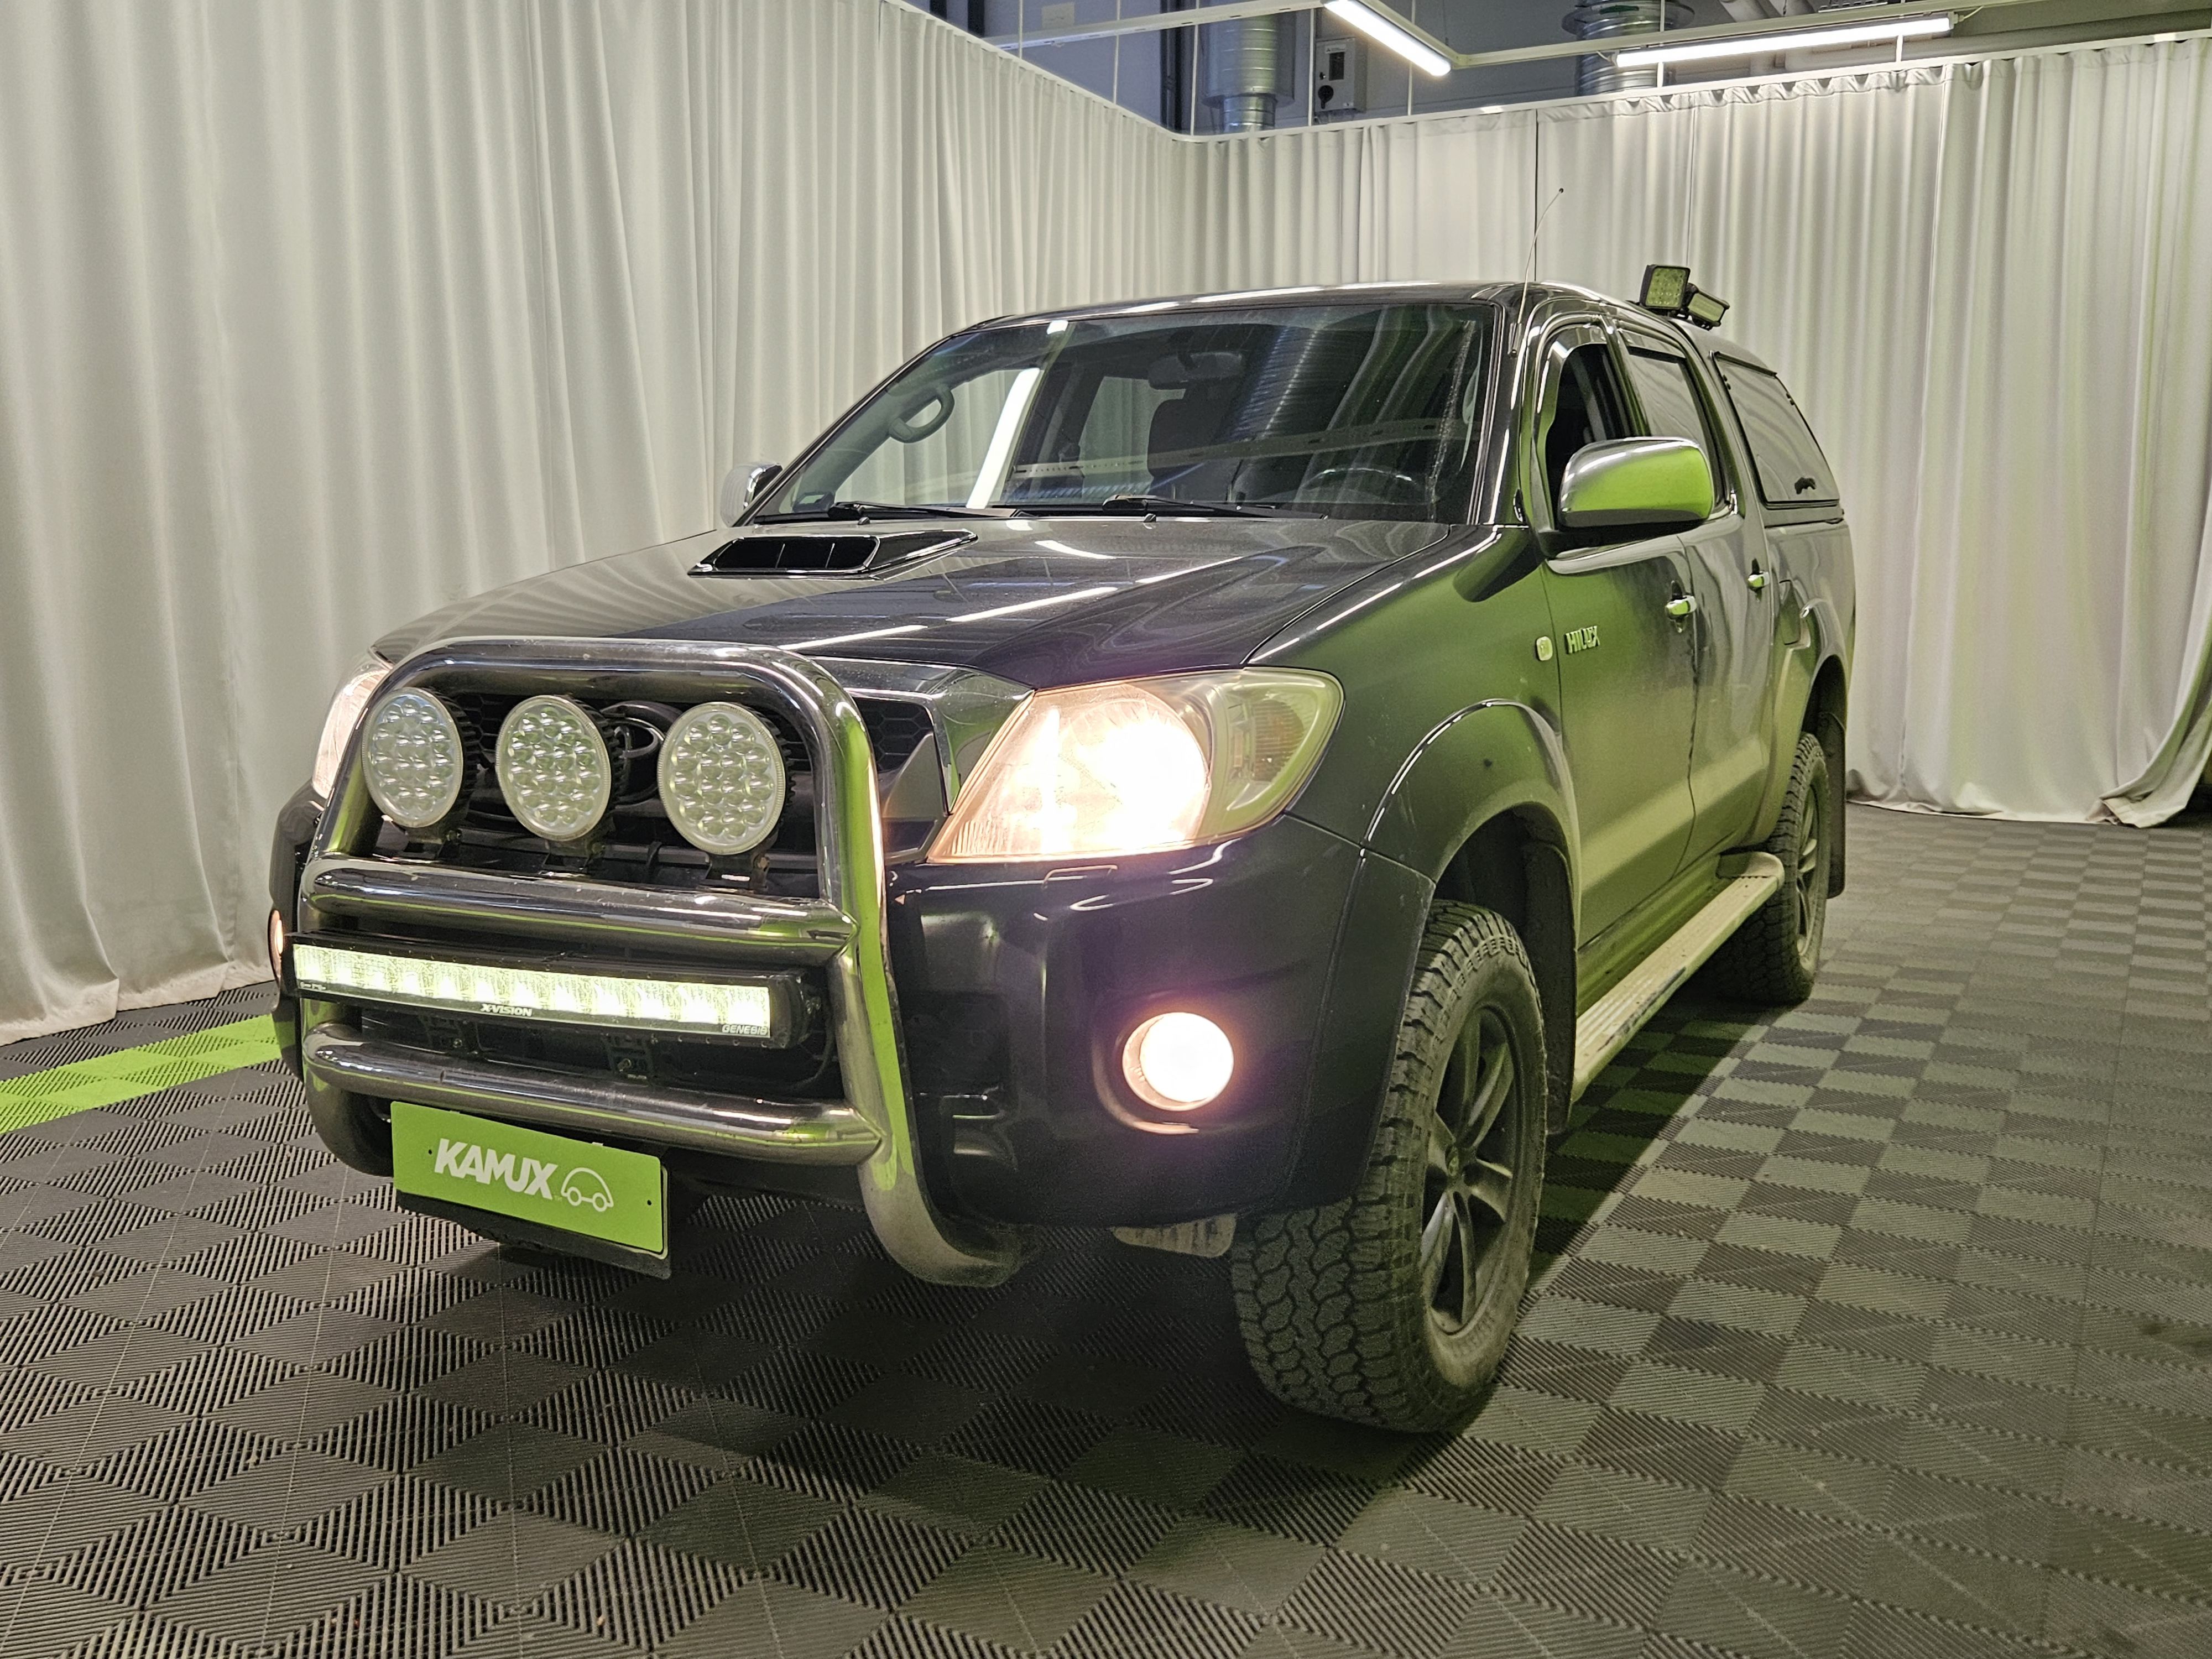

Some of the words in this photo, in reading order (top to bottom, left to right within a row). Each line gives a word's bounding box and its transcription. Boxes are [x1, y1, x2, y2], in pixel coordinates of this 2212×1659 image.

[1565, 625, 1600, 653] HILUX
[722, 1024, 768, 1035] GENESIS
[434, 1138, 559, 1200] KAMUX
